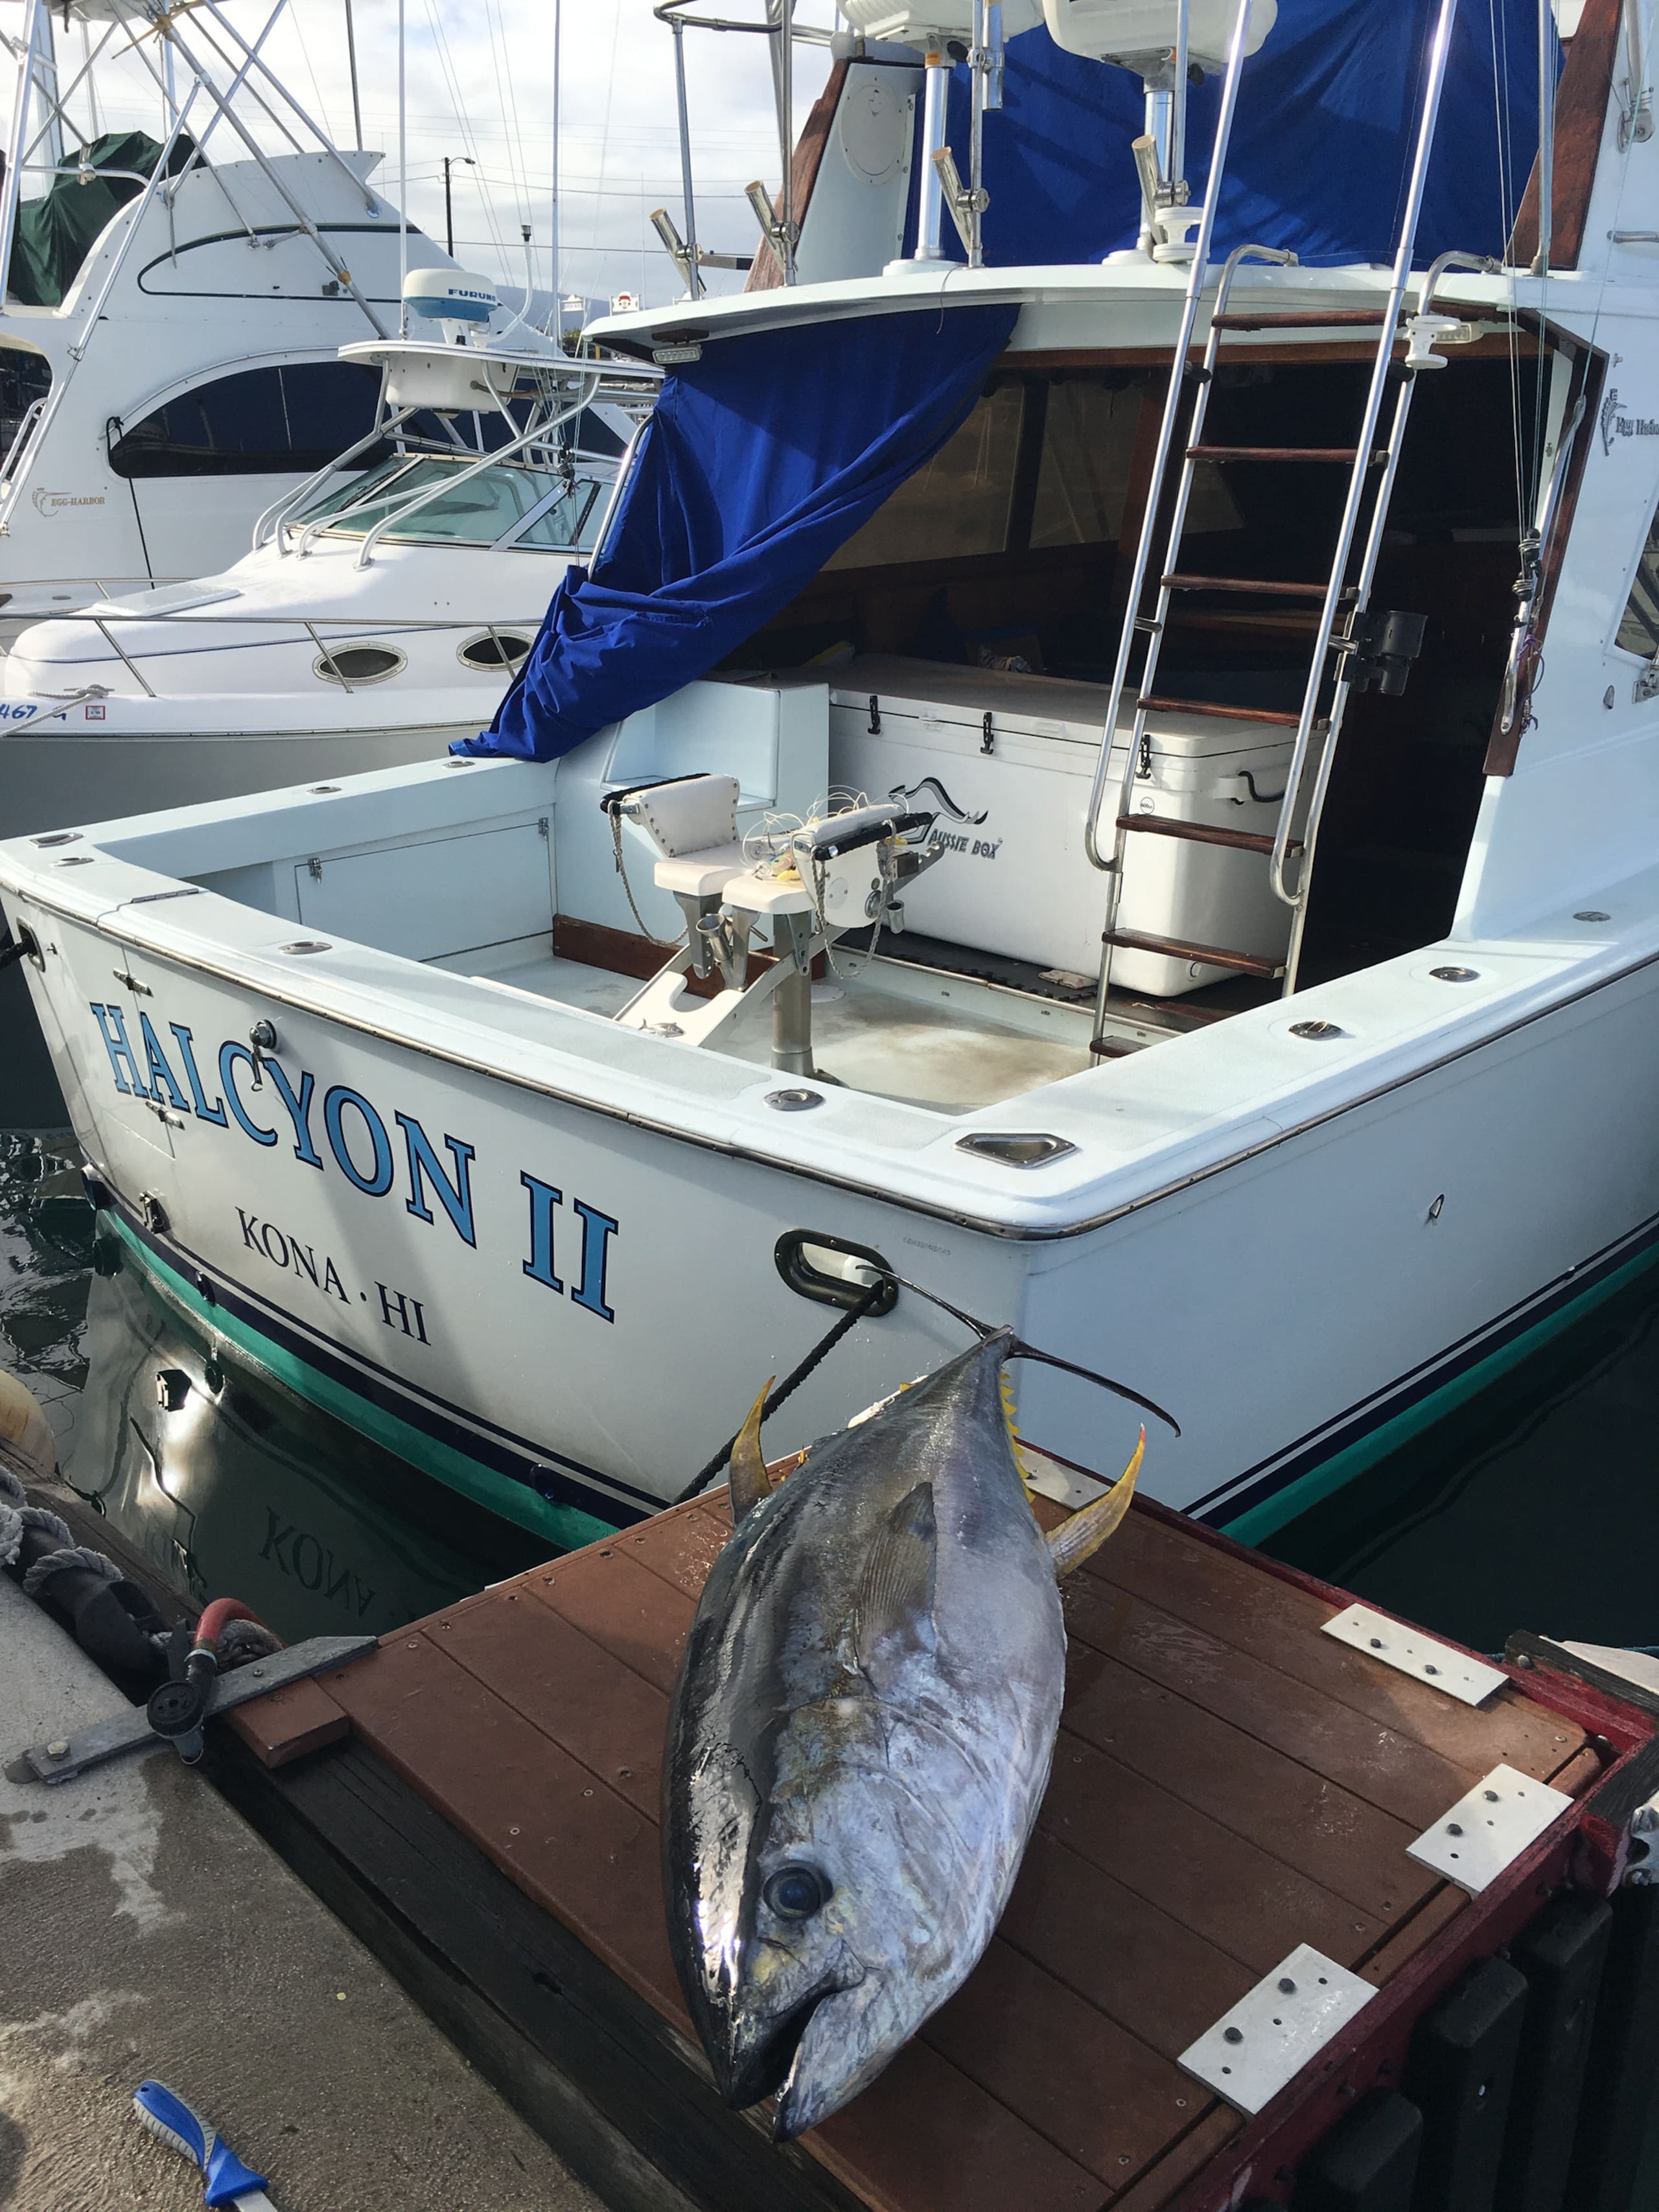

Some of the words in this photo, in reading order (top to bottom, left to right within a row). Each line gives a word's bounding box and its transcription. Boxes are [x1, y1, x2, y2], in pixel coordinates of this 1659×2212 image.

[448, 288, 496, 302] FURUNO
[51, 497, 105, 506] EGG-HARBOR
[927, 828, 969, 852] AUSSIE
[89, 1001, 477, 1250] HALCYON
[520, 1169, 618, 1323] II
[235, 1206, 351, 1304] KONA
[375, 1281, 432, 1347] HI
